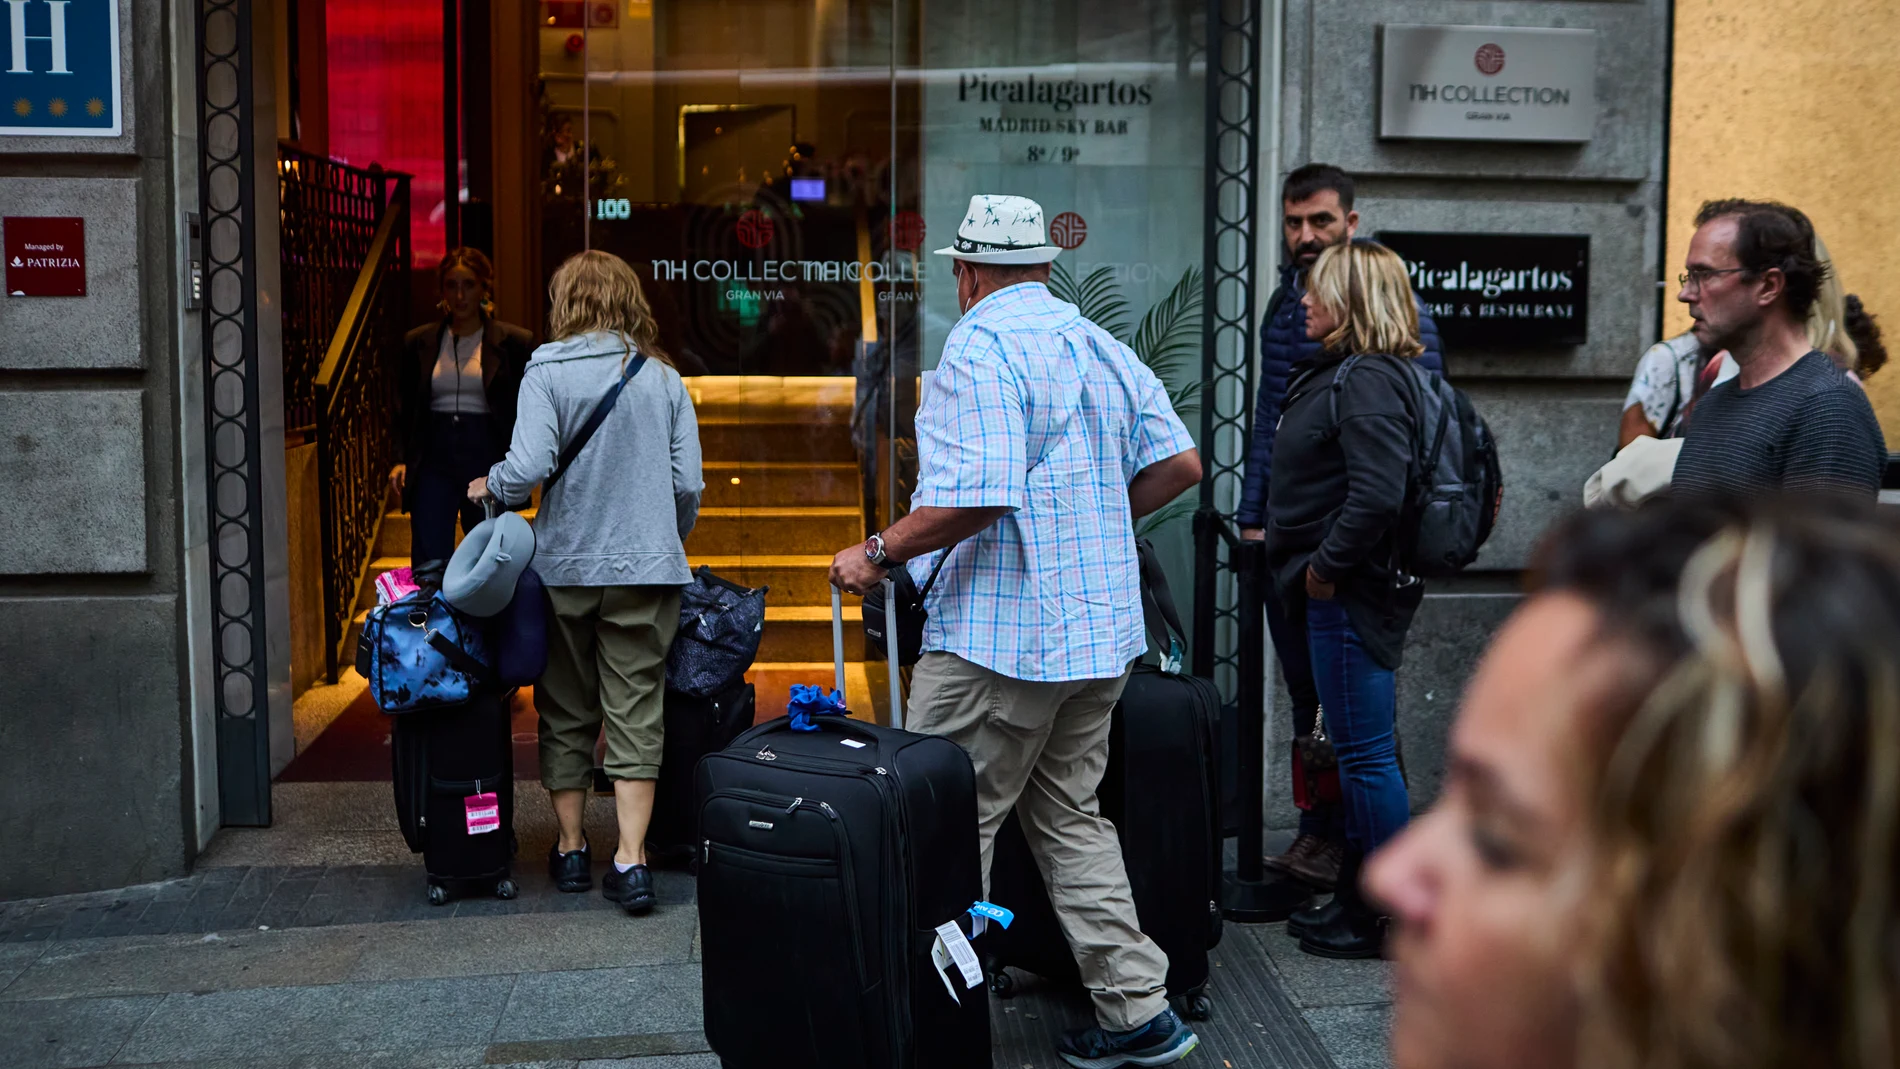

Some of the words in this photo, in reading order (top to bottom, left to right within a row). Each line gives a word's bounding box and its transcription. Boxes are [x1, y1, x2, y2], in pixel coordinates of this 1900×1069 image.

[5, 0, 74, 75] H
[958, 73, 1152, 113] Picalagartos
[1440, 84, 1570, 105] COLLECTION
[979, 116, 1050, 134] MADRID
[1055, 118, 1089, 134] SKY
[1094, 119, 1129, 135] BAR
[24, 243, 54, 252] Managed
[55, 243, 65, 252] by
[27, 257, 80, 268] PATRIZIA
[725, 289, 761, 301] GRAN
[763, 290, 785, 301] VIA
